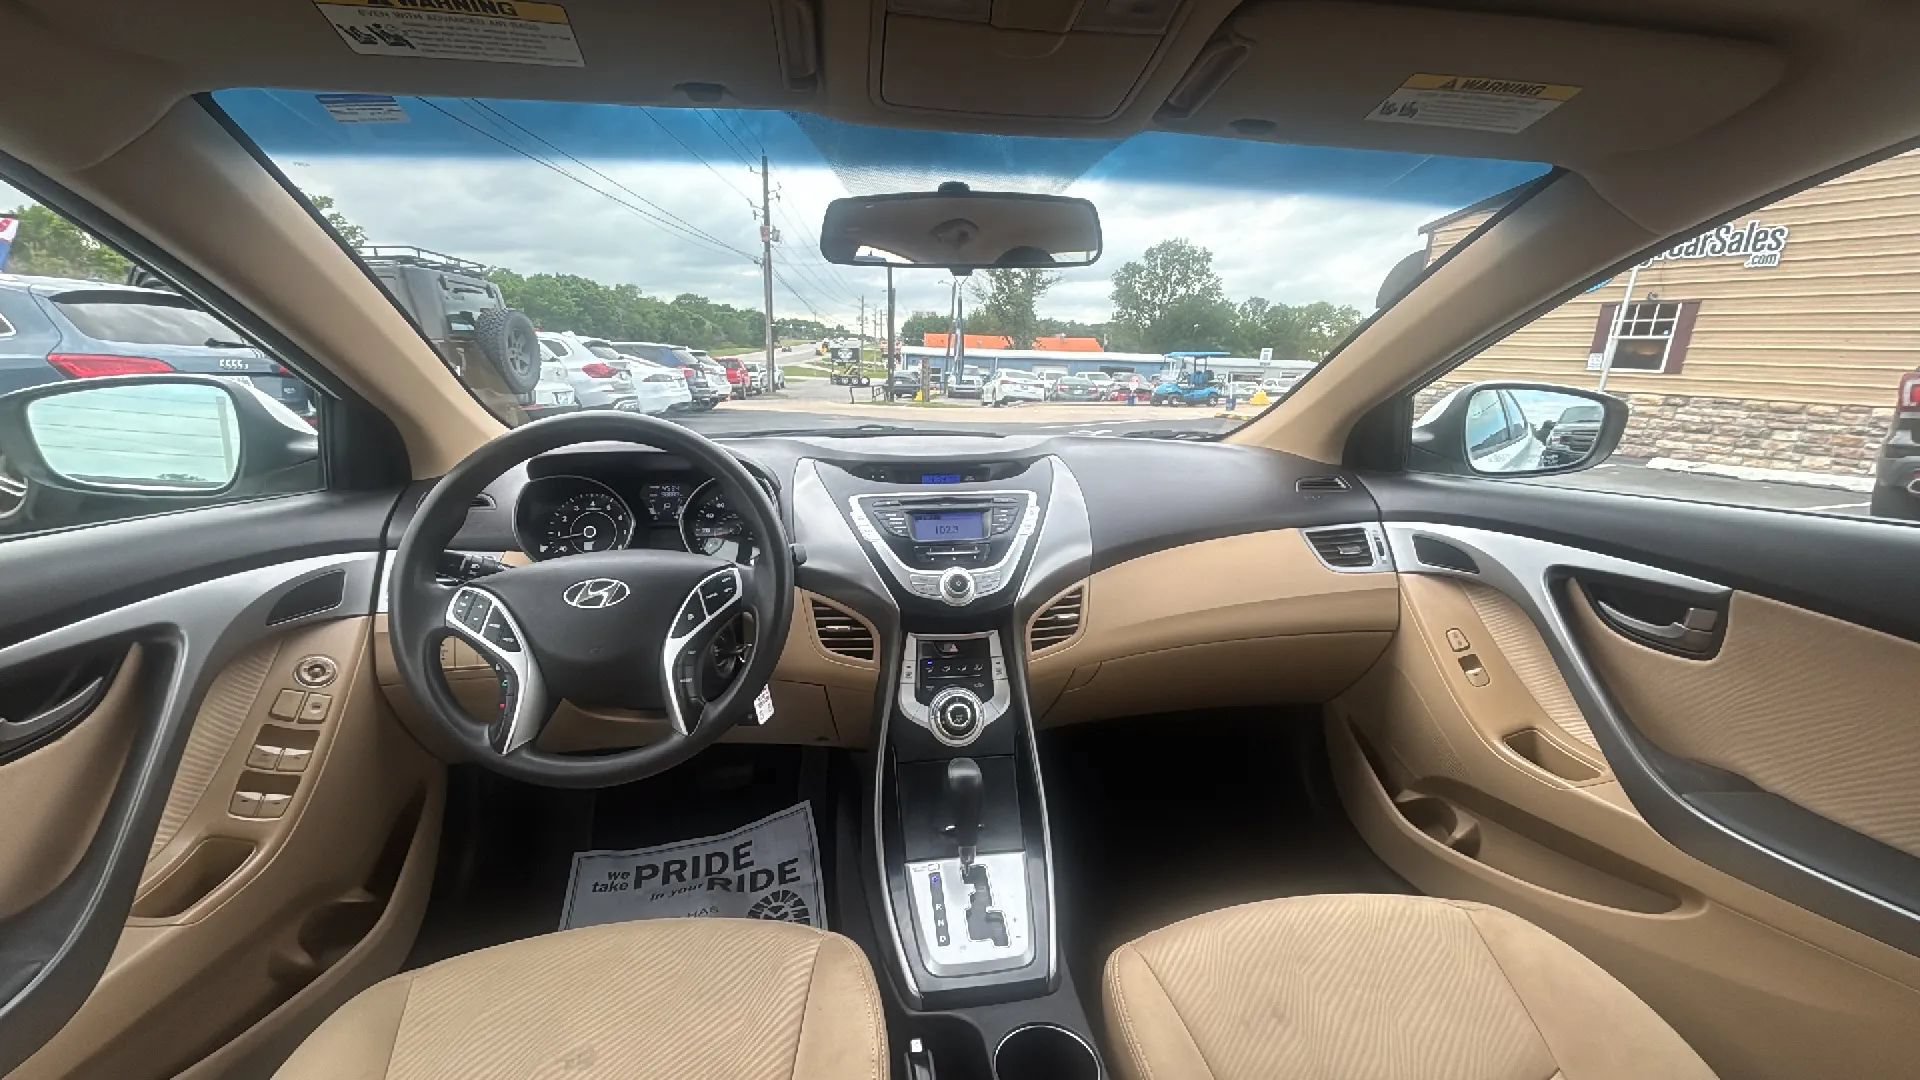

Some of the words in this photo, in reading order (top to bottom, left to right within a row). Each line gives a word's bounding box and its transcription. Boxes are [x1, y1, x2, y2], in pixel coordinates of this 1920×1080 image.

[1462, 79, 1546, 95] WARNING
[633, 839, 756, 890] PRIDE
[607, 870, 631, 881] we
[706, 856, 801, 893] RIDE
[591, 879, 629, 893] take
